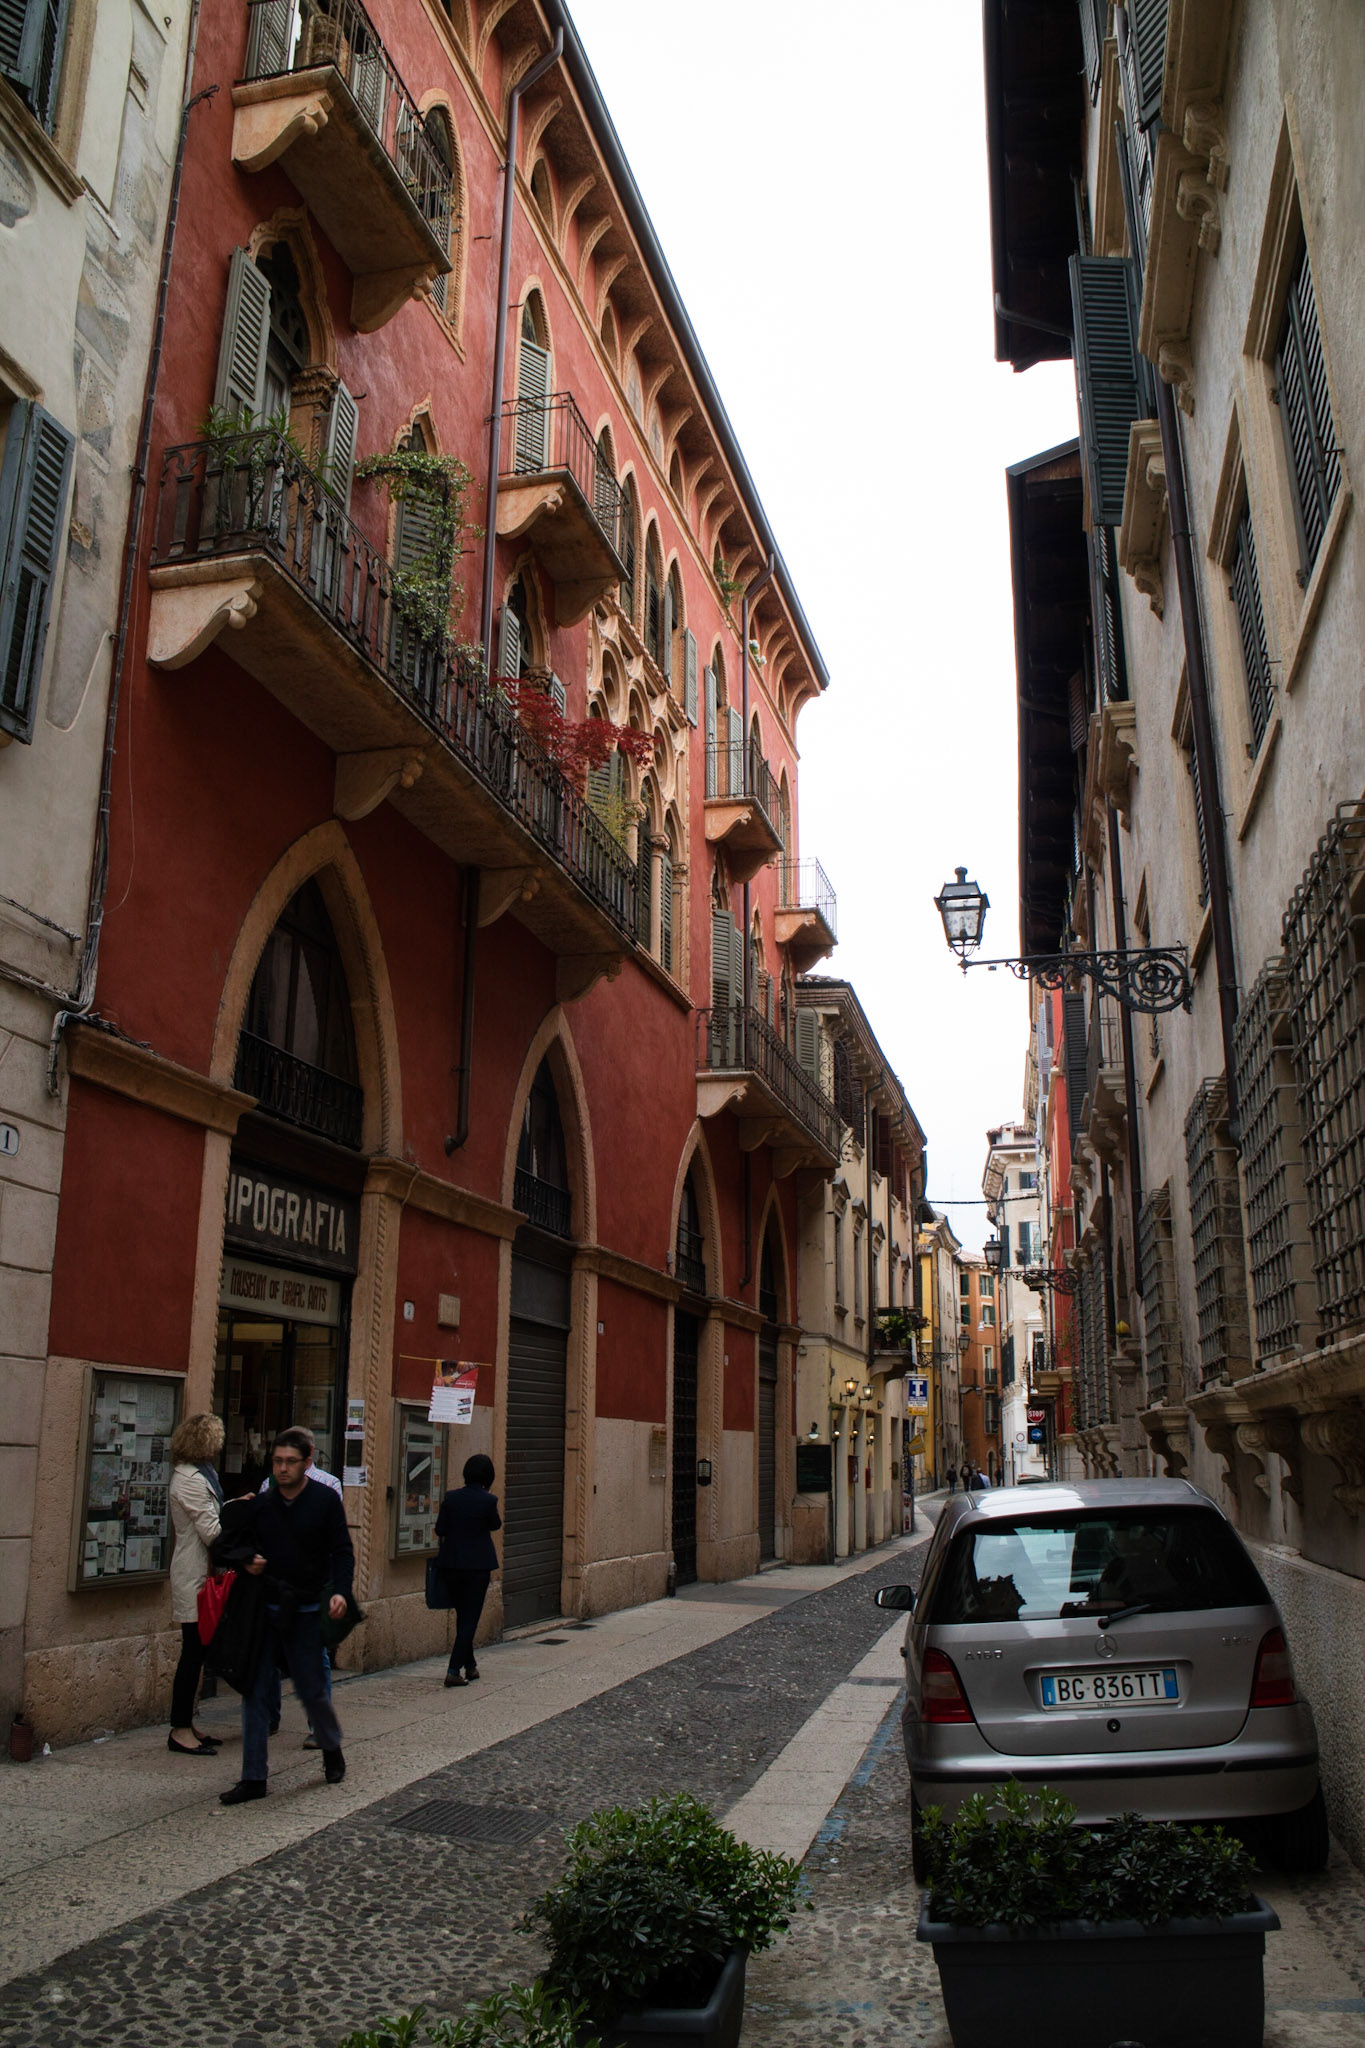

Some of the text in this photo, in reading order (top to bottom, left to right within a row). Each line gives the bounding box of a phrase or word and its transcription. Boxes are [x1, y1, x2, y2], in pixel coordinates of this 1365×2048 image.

[228, 1173, 346, 1255] IPOGRAFIA
[230, 1268, 267, 1301] MUSEUM
[269, 1280, 280, 1299] OF
[307, 1285, 328, 1312] ARTS
[1028, 1410, 1045, 1418] STOP
[1058, 1673, 1161, 1703] BG 836TT
